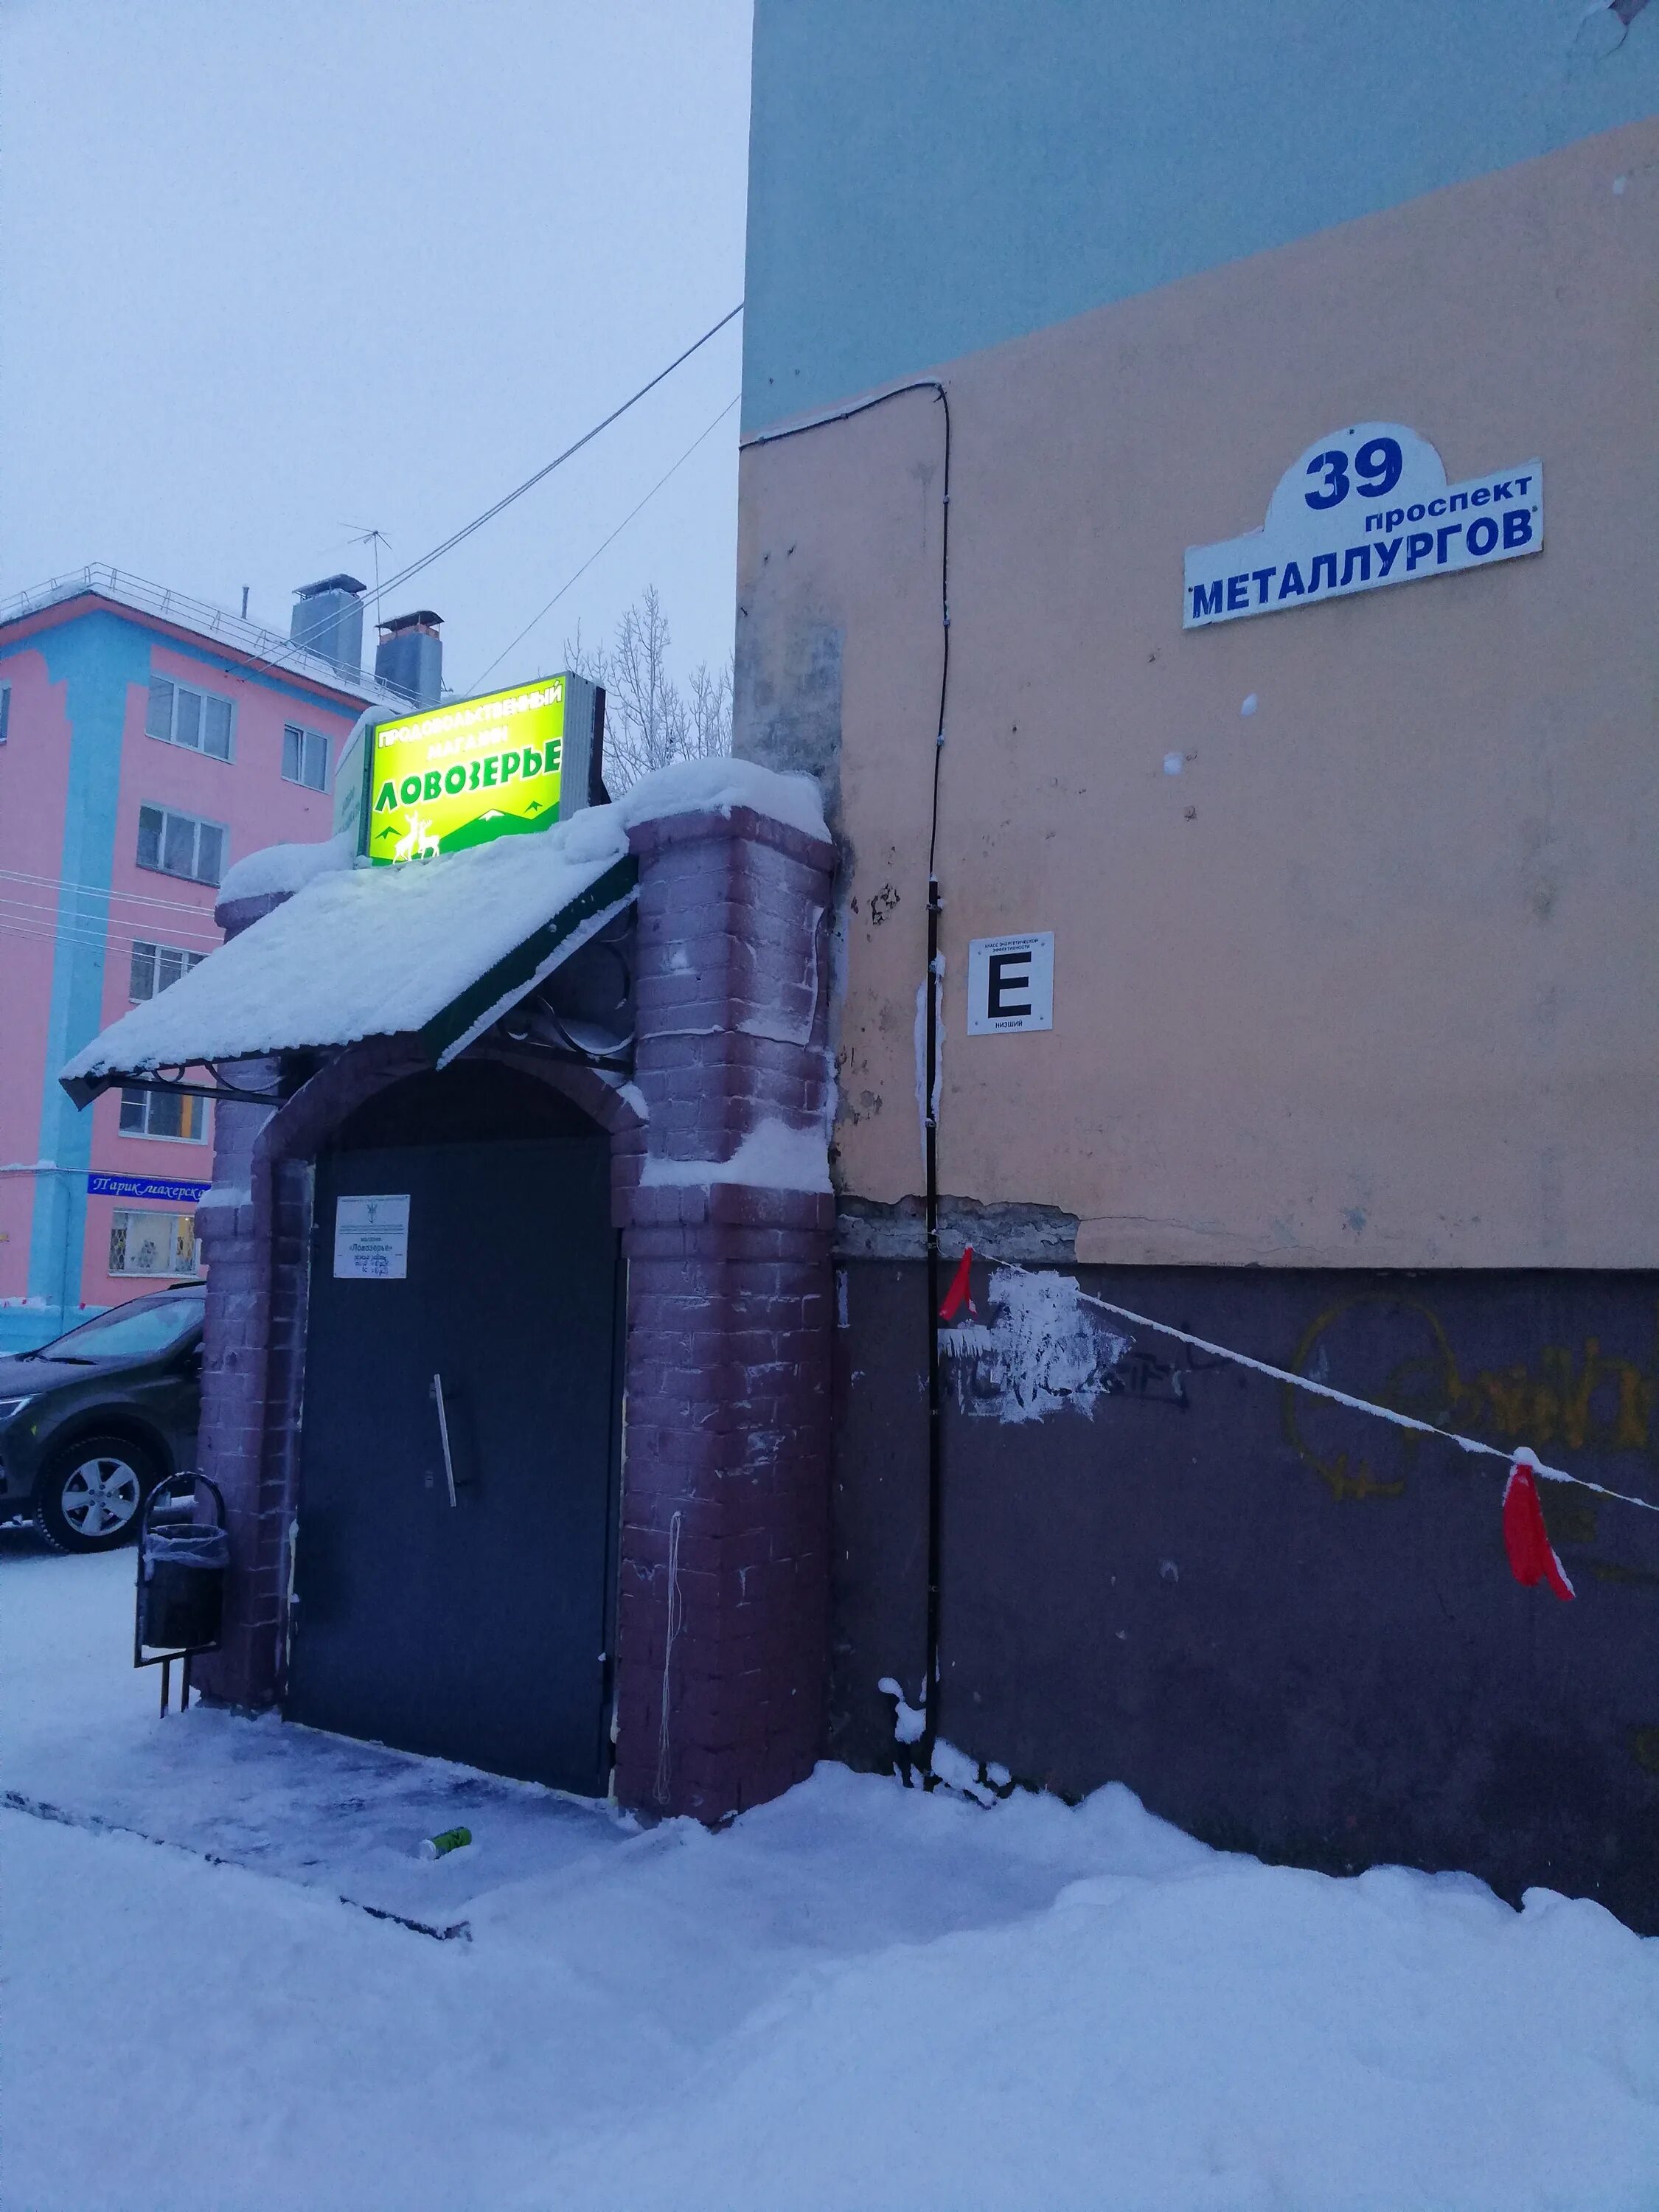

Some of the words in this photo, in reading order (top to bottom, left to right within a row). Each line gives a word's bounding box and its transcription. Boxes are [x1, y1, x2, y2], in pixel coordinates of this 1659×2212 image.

[1304, 437, 1403, 510] 39
[1366, 476, 1533, 532] проспект
[1192, 509, 1533, 619] МЕТАЛЛУРГОВ
[378, 680, 563, 749] ПРОДОВОЛЬСТВЕННЫЙ
[375, 738, 562, 813] ЛОВОЗЕРЬЕ
[987, 951, 1032, 1019] Е
[995, 1020, 1023, 1029] НИЗШИЙ
